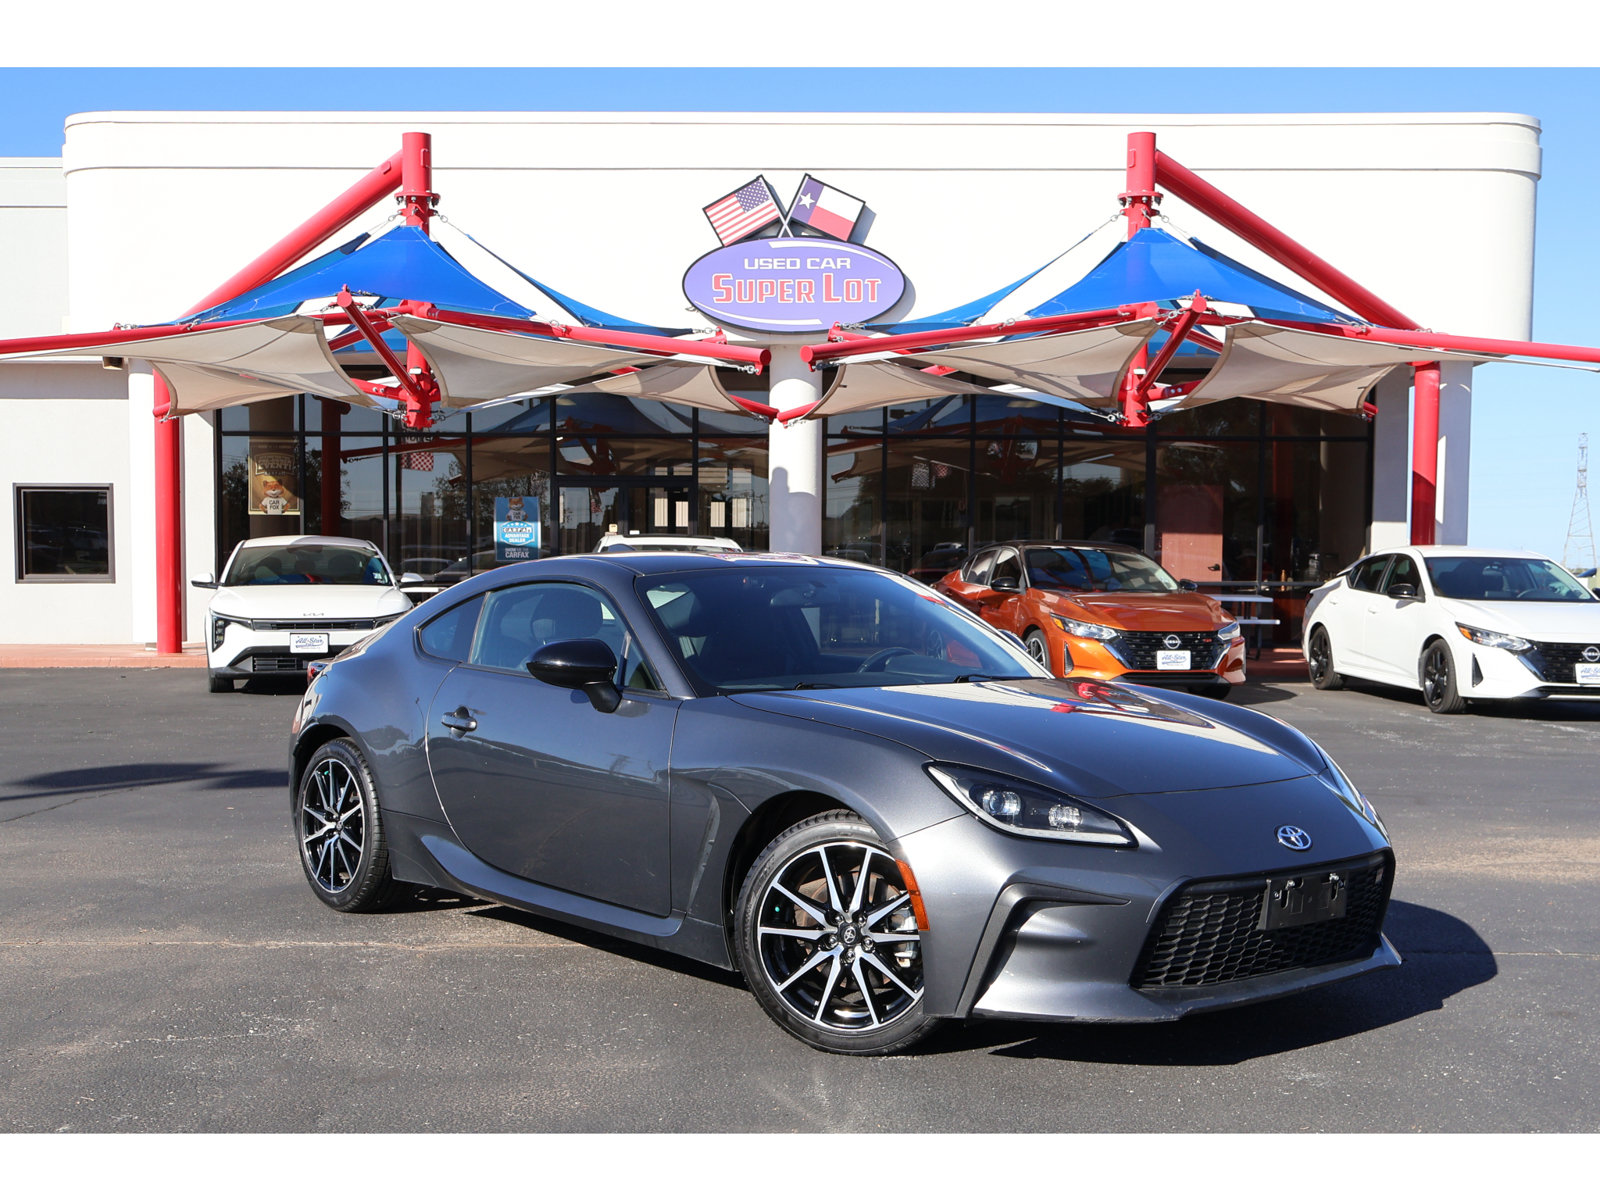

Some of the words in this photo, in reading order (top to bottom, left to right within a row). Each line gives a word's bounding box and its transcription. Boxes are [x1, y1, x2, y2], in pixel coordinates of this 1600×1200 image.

[744, 258, 800, 269] USED
[806, 258, 850, 269] CAR
[712, 273, 815, 303] SUPER
[822, 272, 882, 303] LOT
